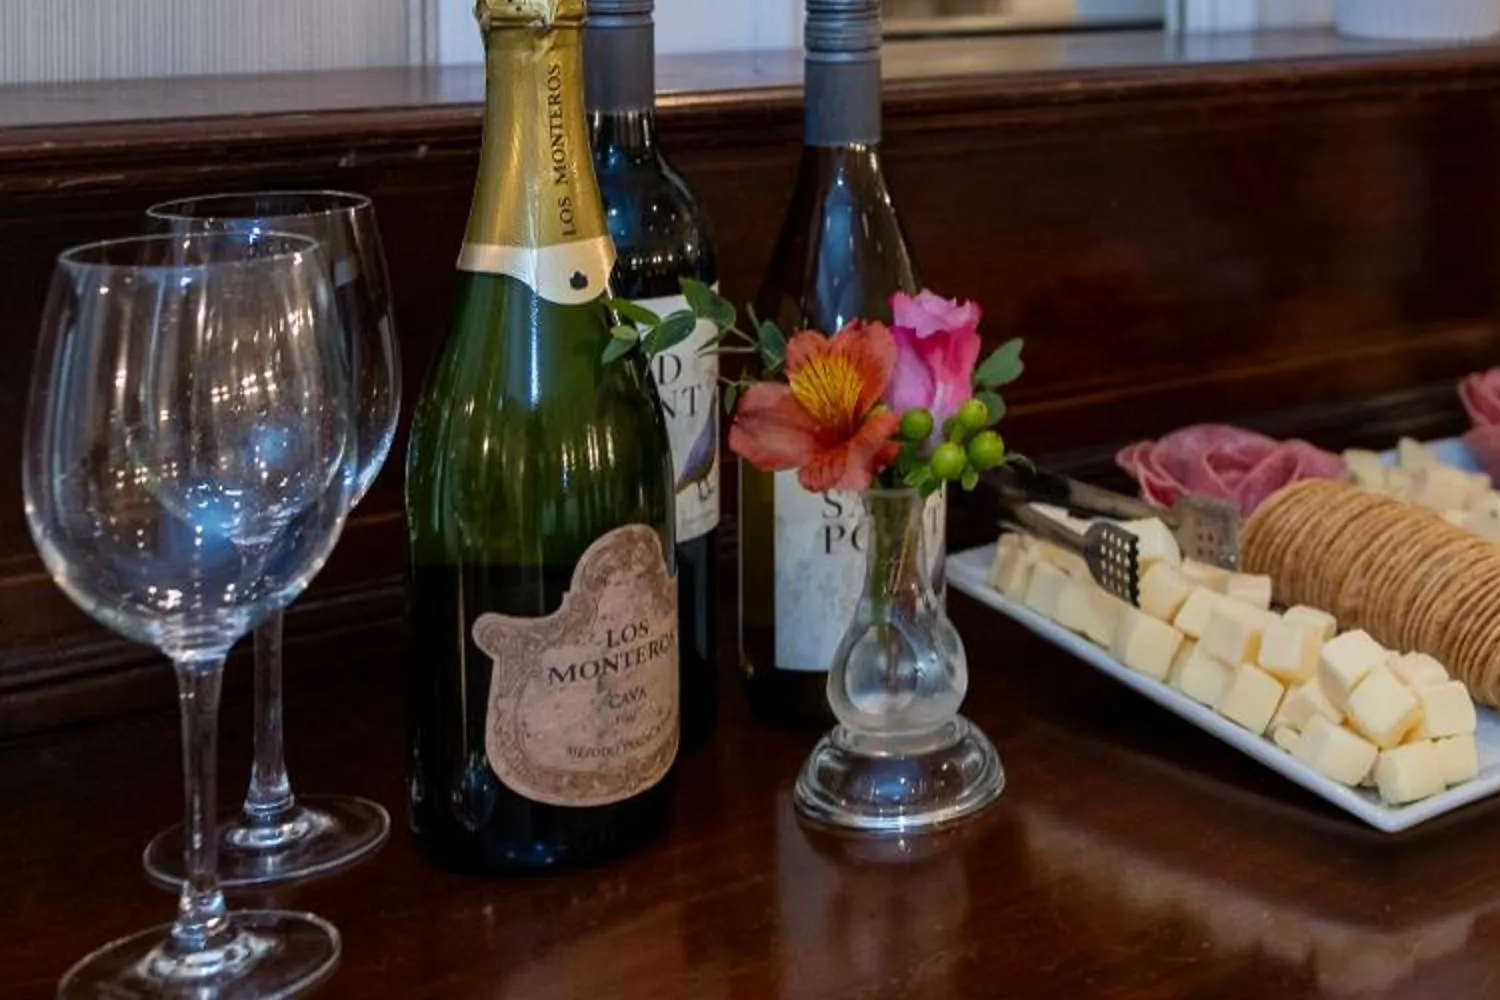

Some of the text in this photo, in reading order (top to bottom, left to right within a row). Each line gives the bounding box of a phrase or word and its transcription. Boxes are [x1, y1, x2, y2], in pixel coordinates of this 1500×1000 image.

[548, 64, 577, 237] LOS MONTEROS
[606, 619, 650, 649] LOS
